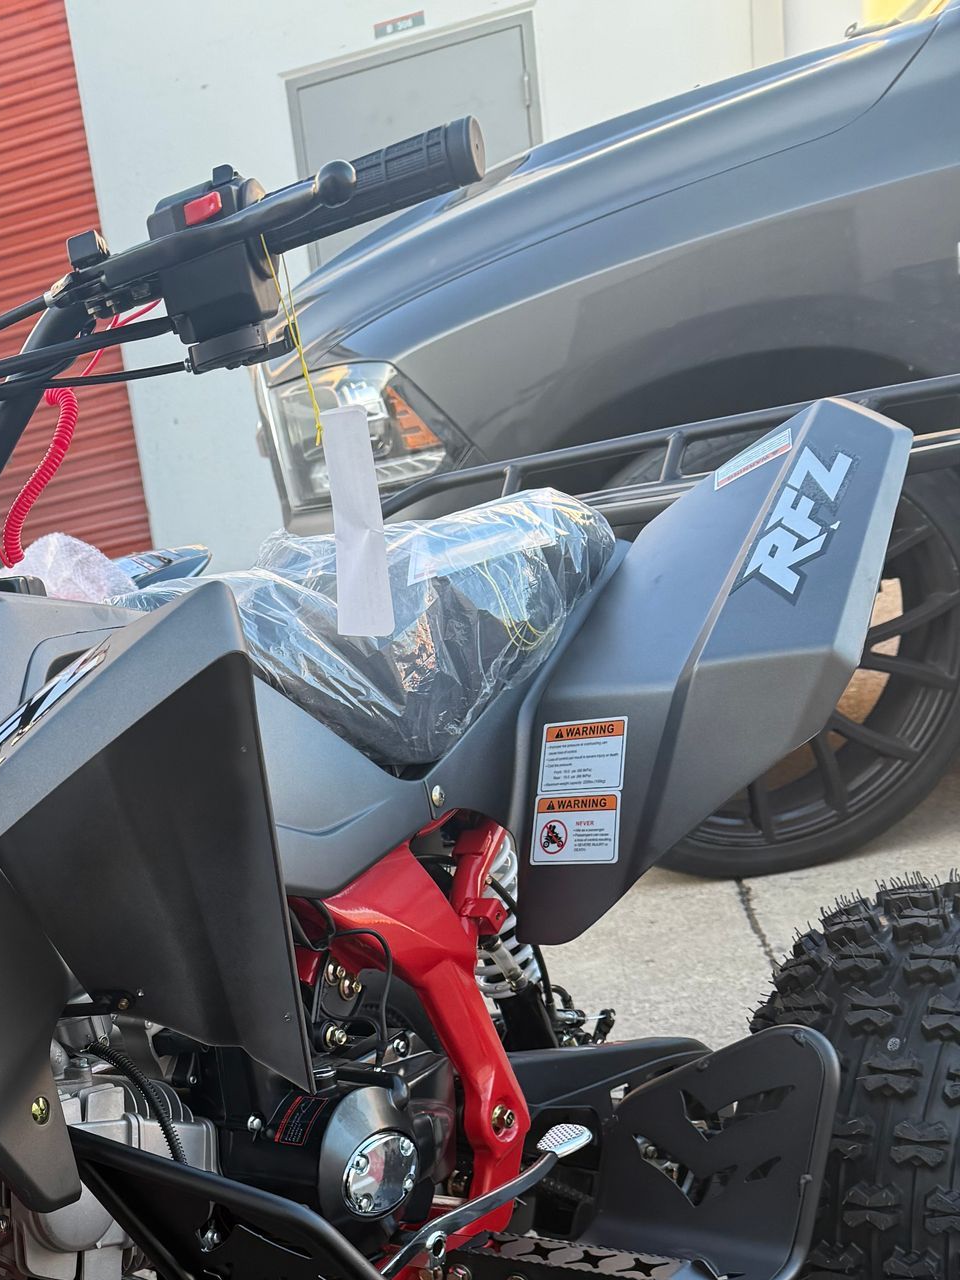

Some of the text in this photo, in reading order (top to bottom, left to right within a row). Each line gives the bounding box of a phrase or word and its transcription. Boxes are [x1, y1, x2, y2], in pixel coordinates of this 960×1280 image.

[742, 445, 853, 595] RFZ
[565, 724, 614, 737] WARNING
[557, 798, 607, 809] WARNING
